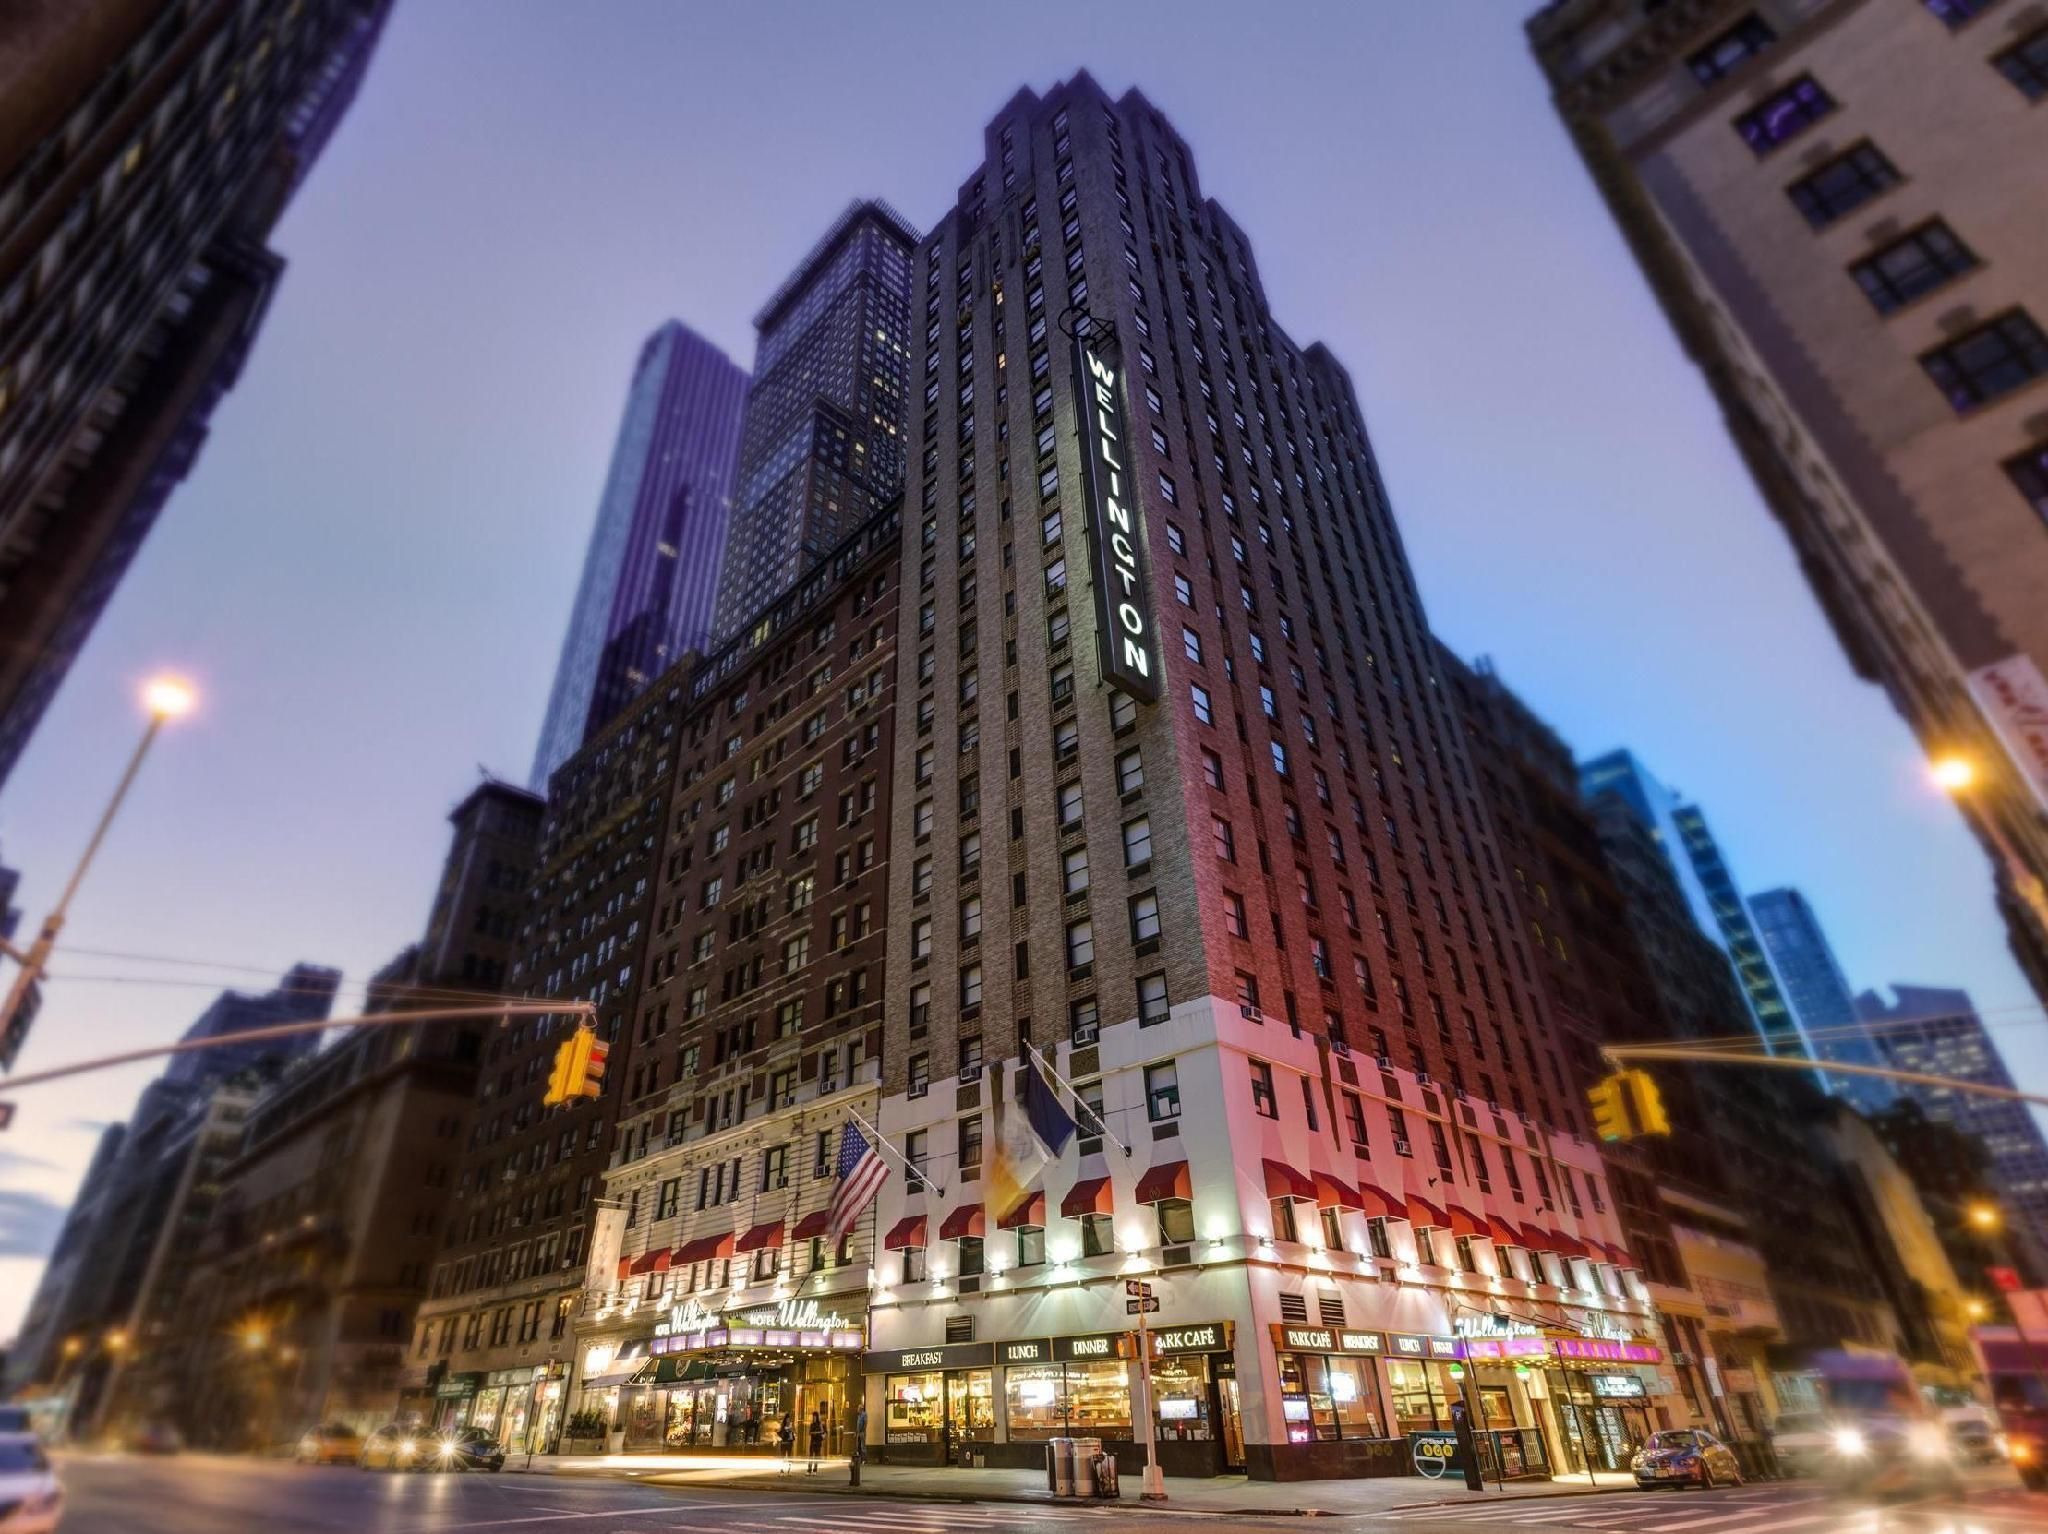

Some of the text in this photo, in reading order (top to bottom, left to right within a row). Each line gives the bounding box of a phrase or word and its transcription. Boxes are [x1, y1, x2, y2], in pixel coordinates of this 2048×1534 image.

[1086, 349, 1149, 678] WELLINGTON
[750, 1300, 850, 1336] HOTEL Wellington
[1157, 1326, 1216, 1350] ARK CAFÉ
[1288, 1331, 1332, 1348] PARK CAFÉ
[1008, 1345, 1039, 1360] LUNCH
[1072, 1339, 1109, 1355] DINNER
[901, 1351, 943, 1367] BREAKFAST
